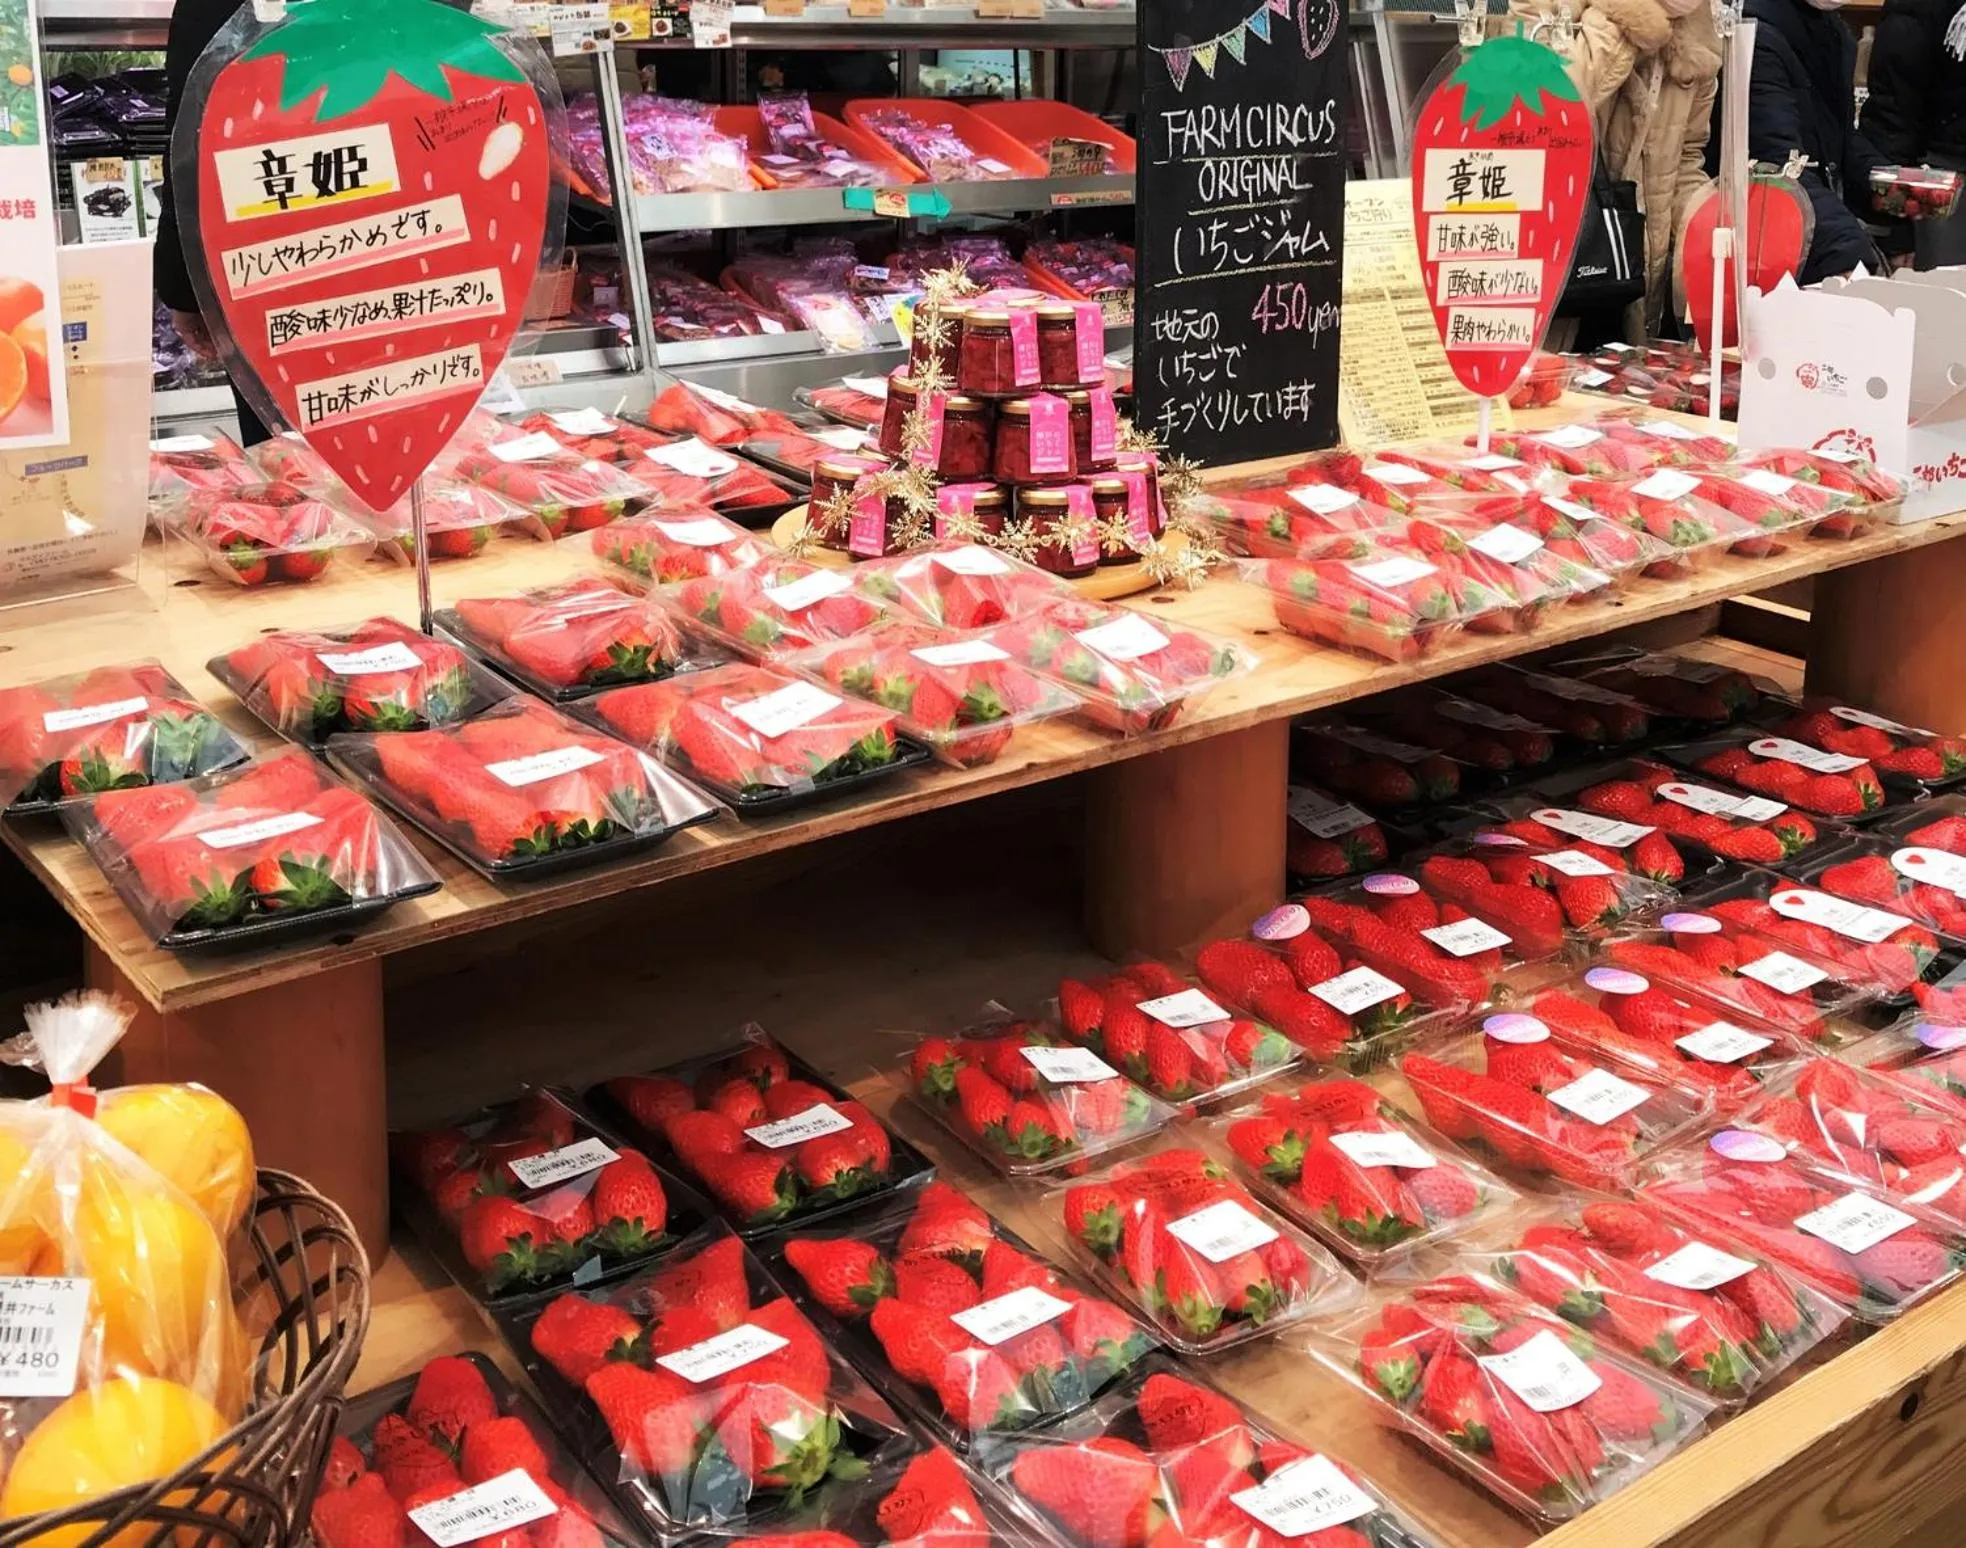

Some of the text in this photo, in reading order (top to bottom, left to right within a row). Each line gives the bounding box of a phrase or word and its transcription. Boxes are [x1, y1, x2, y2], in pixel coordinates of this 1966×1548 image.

[1160, 103, 1241, 158] FARM
[1245, 99, 1337, 148] CIRCUS
[253, 143, 368, 210] 章姫
[1198, 158, 1313, 202] ORIGINAL
[1446, 157, 1513, 206] 章姫
[231, 208, 443, 287] 少しやわらかめです。
[1173, 209, 1330, 275] いちごジャム
[1436, 221, 1515, 254] 甘味が強い。
[1447, 267, 1538, 299] 酸味が少ない。
[269, 281, 494, 348] 酸味少なめ、果汁たっぷり。
[1151, 309, 1220, 343] 地元の
[1449, 314, 1531, 344] 果肉やわらかい。
[1159, 342, 1248, 387] いちごで
[301, 354, 480, 426] 甘味がしっかりです。
[1156, 377, 1317, 443] 手づくりしています
[0, 1302, 56, 1316] 井ファーム
